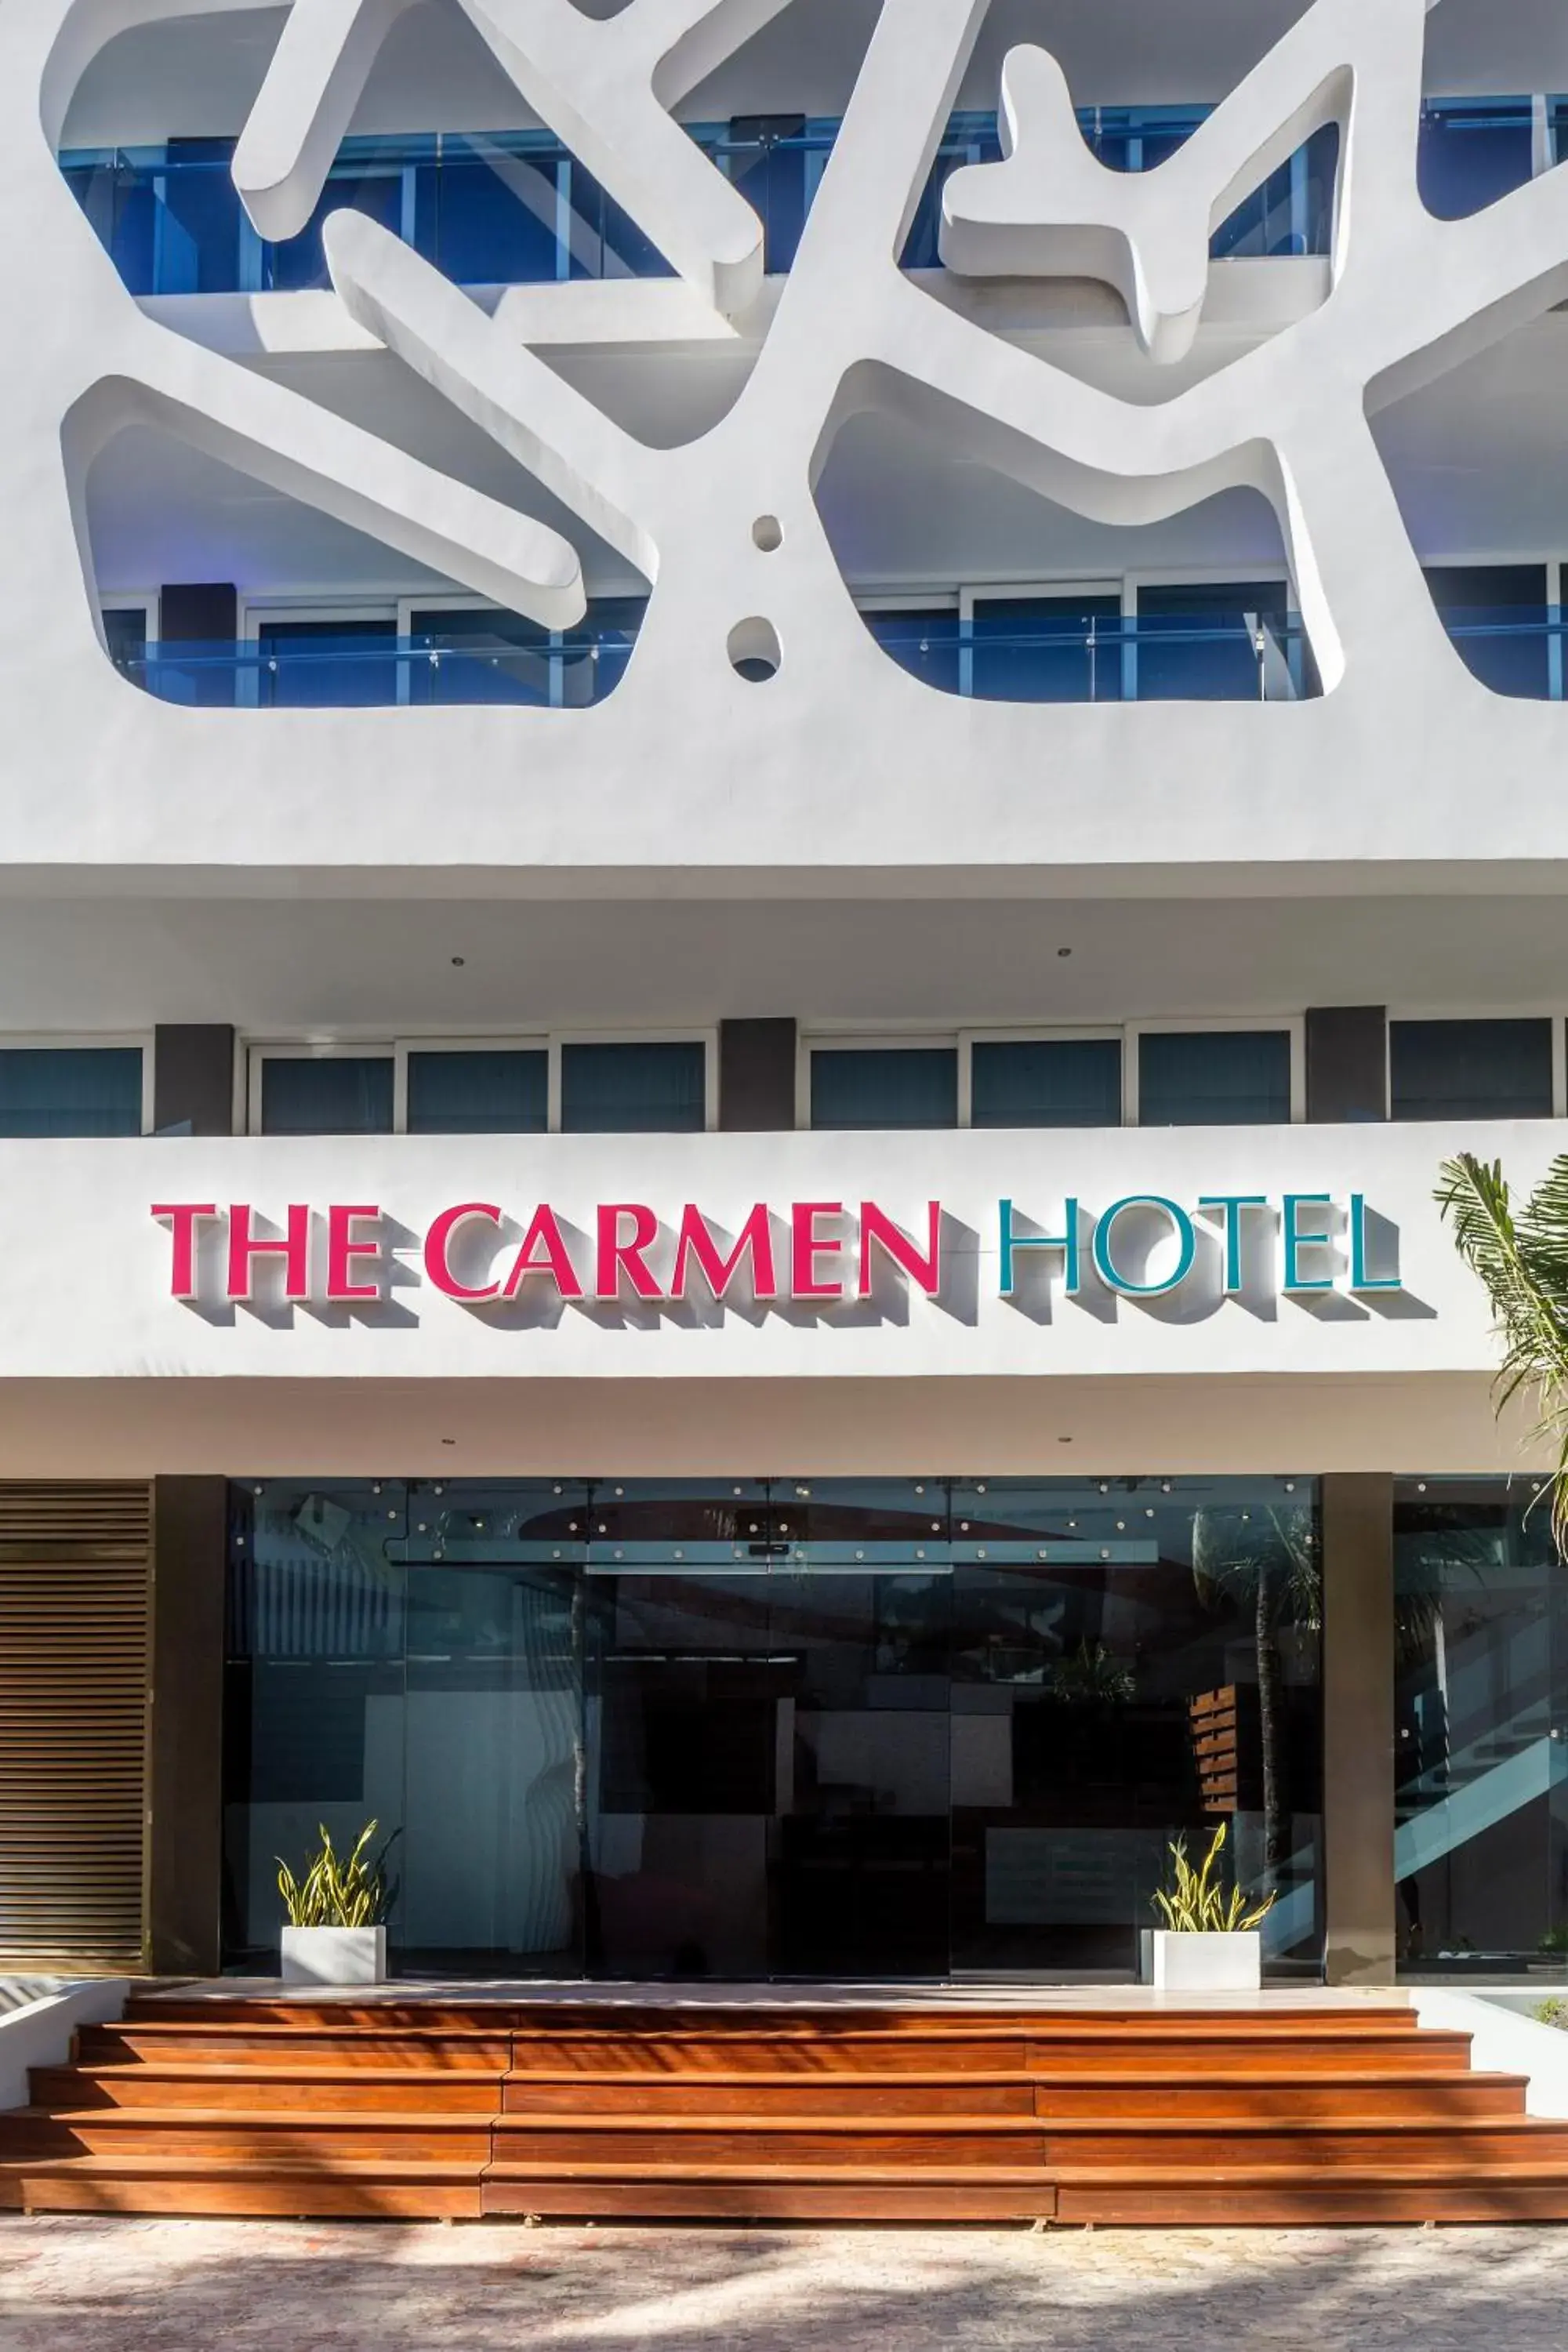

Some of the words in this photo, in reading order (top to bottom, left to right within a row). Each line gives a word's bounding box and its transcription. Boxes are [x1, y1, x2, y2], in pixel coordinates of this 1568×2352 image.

[151, 1203, 381, 1299] THE
[423, 1202, 941, 1299] CARMEN
[998, 1194, 1403, 1295] HOTEL
